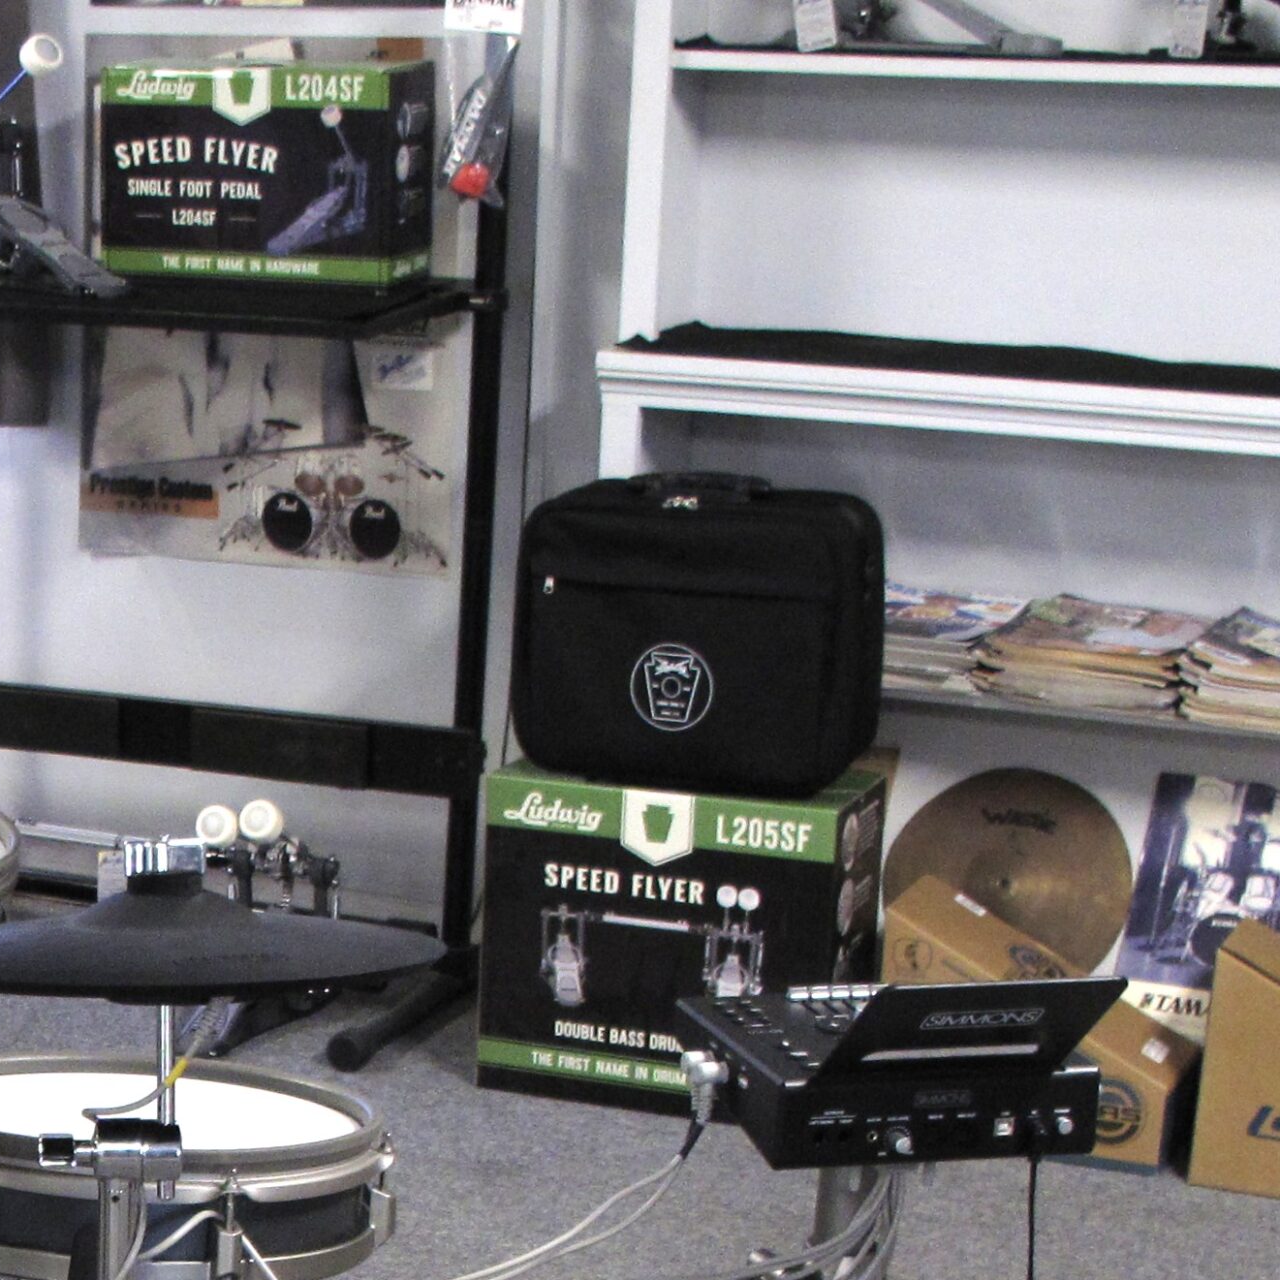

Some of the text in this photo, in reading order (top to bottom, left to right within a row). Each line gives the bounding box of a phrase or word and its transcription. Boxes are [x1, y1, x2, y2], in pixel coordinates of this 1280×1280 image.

[117, 70, 197, 101] Ludwig
[285, 74, 366, 102] L204SF
[114, 136, 280, 174] SPEED FLYER
[127, 178, 263, 200] SINGLE FOOT PEDAL
[172, 209, 217, 227] L204SF
[162, 253, 320, 275] THE FIRST NAME IN HARDWARE
[503, 791, 603, 832] Ludwig
[716, 815, 812, 853] L205SF
[544, 863, 704, 905] SPEED FLYER
[925, 1010, 1039, 1028] SIMMONS
[1158, 994, 1209, 1017] TAM
[554, 1020, 605, 1044] DOUBLE
[609, 1026, 645, 1049] BASS
[532, 1051, 553, 1067] THE
[558, 1056, 591, 1073] FIRST
[596, 1060, 630, 1078] NAME
[634, 1066, 648, 1080] IN
